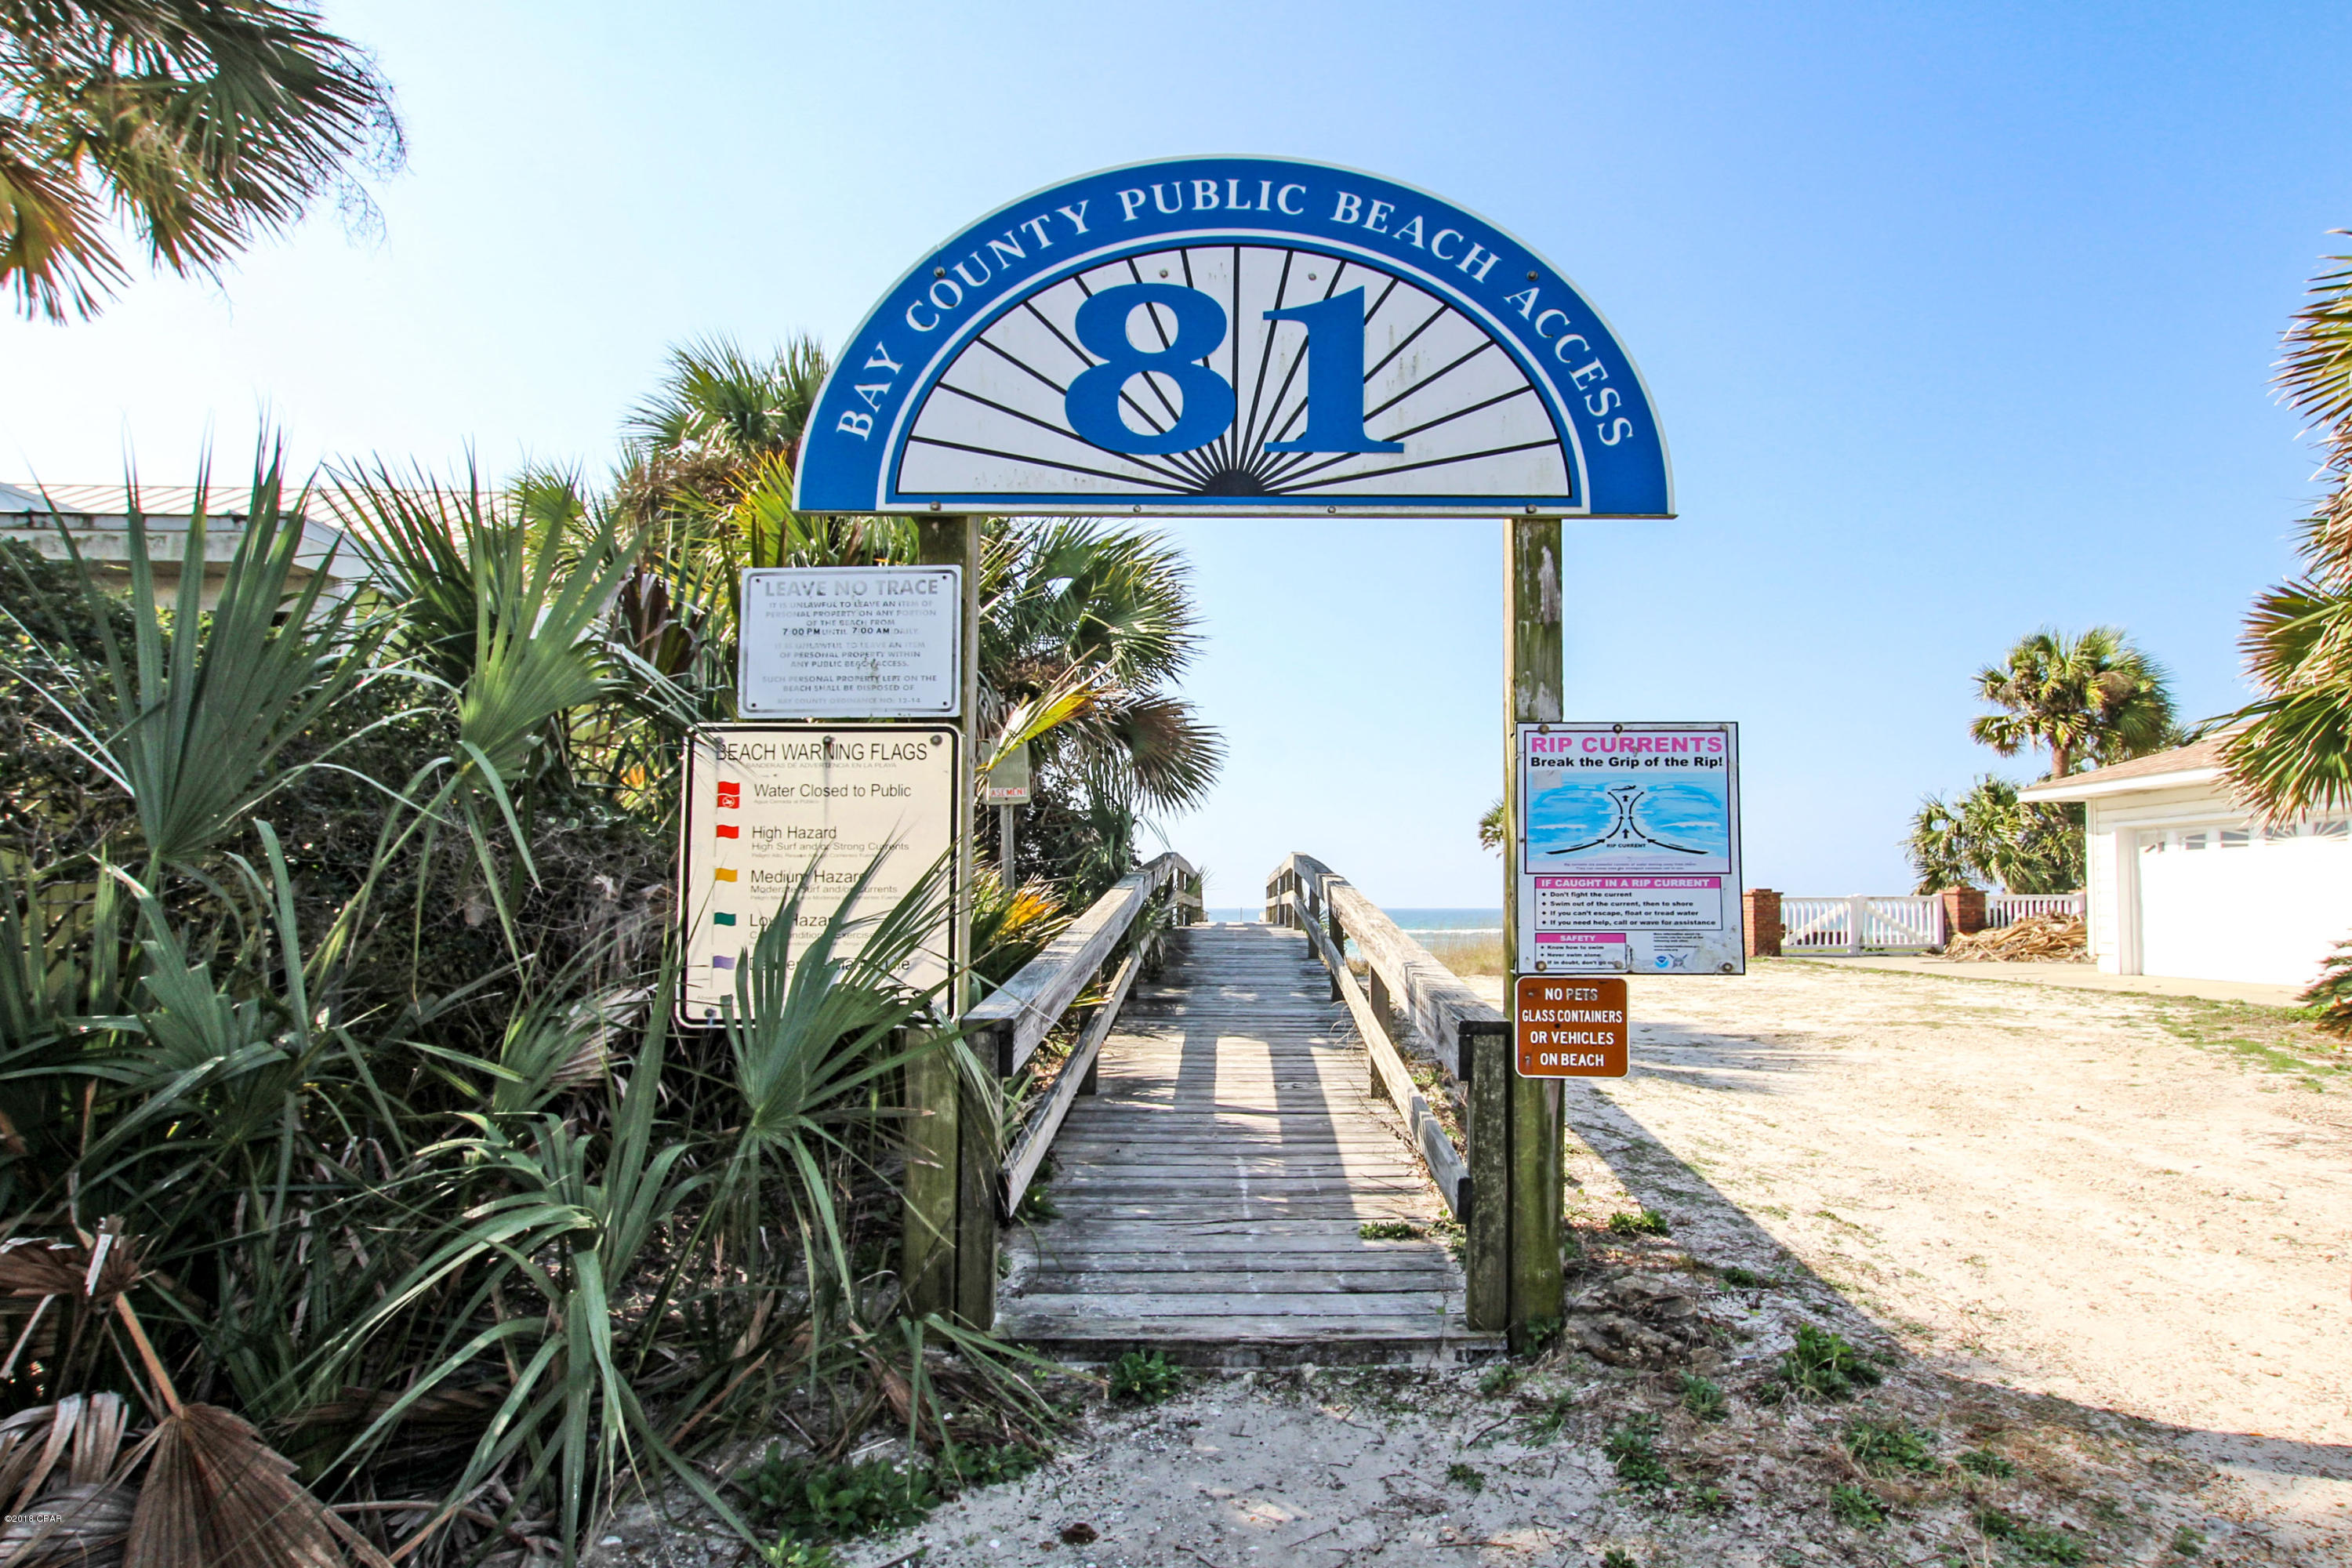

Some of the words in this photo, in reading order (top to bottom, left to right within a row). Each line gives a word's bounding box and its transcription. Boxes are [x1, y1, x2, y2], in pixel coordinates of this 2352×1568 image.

[836, 342, 906, 442] BAY
[906, 199, 1092, 332] COUNTY
[1116, 179, 1307, 221] PUBLIC
[1331, 191, 1501, 284] BEACH
[1503, 287, 1633, 447] ACCESS
[1065, 282, 1404, 456] 81
[765, 581, 826, 596] LEAVE
[835, 580, 867, 596] NO
[876, 579, 938, 595] TRACE
[716, 743, 776, 760] BEACH
[782, 743, 865, 760] WARNING
[870, 743, 927, 760] FLAGS
[1530, 737, 1573, 753] RIP
[1581, 736, 1723, 753] CURRENTS
[1530, 757, 1575, 767] Break
[1579, 757, 1604, 767] the
[1608, 757, 1640, 769] Grip
[1645, 757, 1660, 767] of
[1664, 757, 1690, 767] the
[1693, 757, 1723, 769] Rip!
[753, 783, 795, 797] Water
[800, 783, 848, 797] Closed
[853, 784, 866, 797] to
[871, 783, 912, 797] Public
[752, 826, 782, 843] High
[787, 826, 837, 839] Hazard
[752, 842, 773, 852] High
[776, 842, 797, 851] Surf
[832, 842, 865, 852] Strong
[814, 869, 863, 884] Hazar
[1541, 879, 1551, 887] IF
[1555, 879, 1602, 887] CAUGHT
[1605, 879, 1618, 887] IN
[1620, 879, 1628, 887] A
[1632, 879, 1651, 887] RIP
[1653, 879, 1710, 887] CURRENT
[822, 885, 851, 894] and/o
[862, 885, 898, 894] urrents
[1544, 988, 1563, 1000] NO
[1566, 988, 1599, 1001] PETS
[1522, 1010, 1555, 1022] GLASS
[1557, 1010, 1623, 1023] CONTAINERS
[1530, 1031, 1548, 1044] OR
[1551, 1031, 1615, 1045] VEHICLES
[1540, 1053, 1558, 1065] ON
[1561, 1053, 1604, 1066] BEACH
